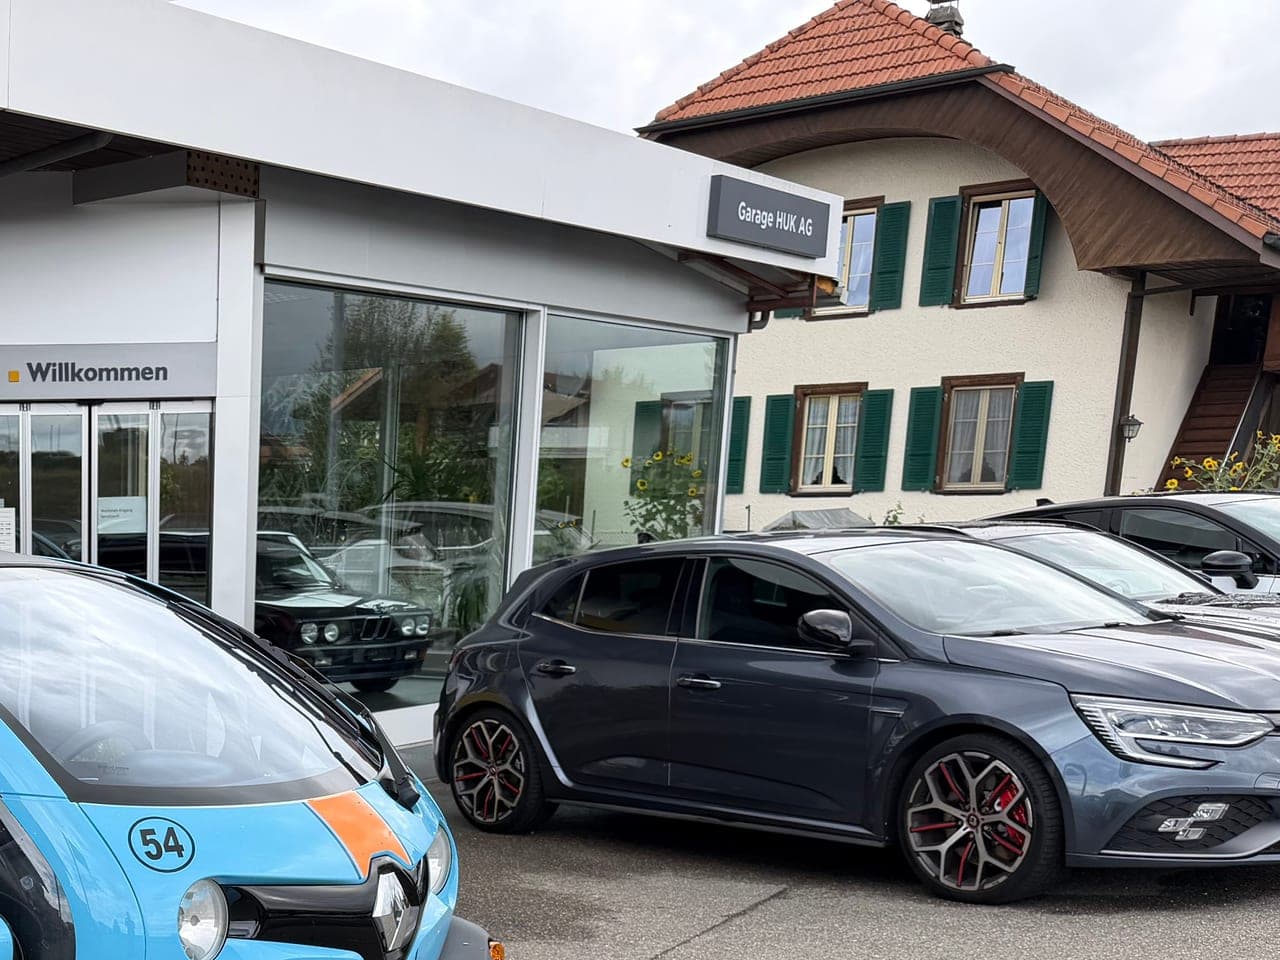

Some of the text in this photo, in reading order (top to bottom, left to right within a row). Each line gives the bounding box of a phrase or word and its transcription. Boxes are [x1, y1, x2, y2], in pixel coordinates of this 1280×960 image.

[738, 201, 813, 237] Garage HUK AG
[26, 362, 168, 382] Willkommen
[140, 827, 184, 860] 54
